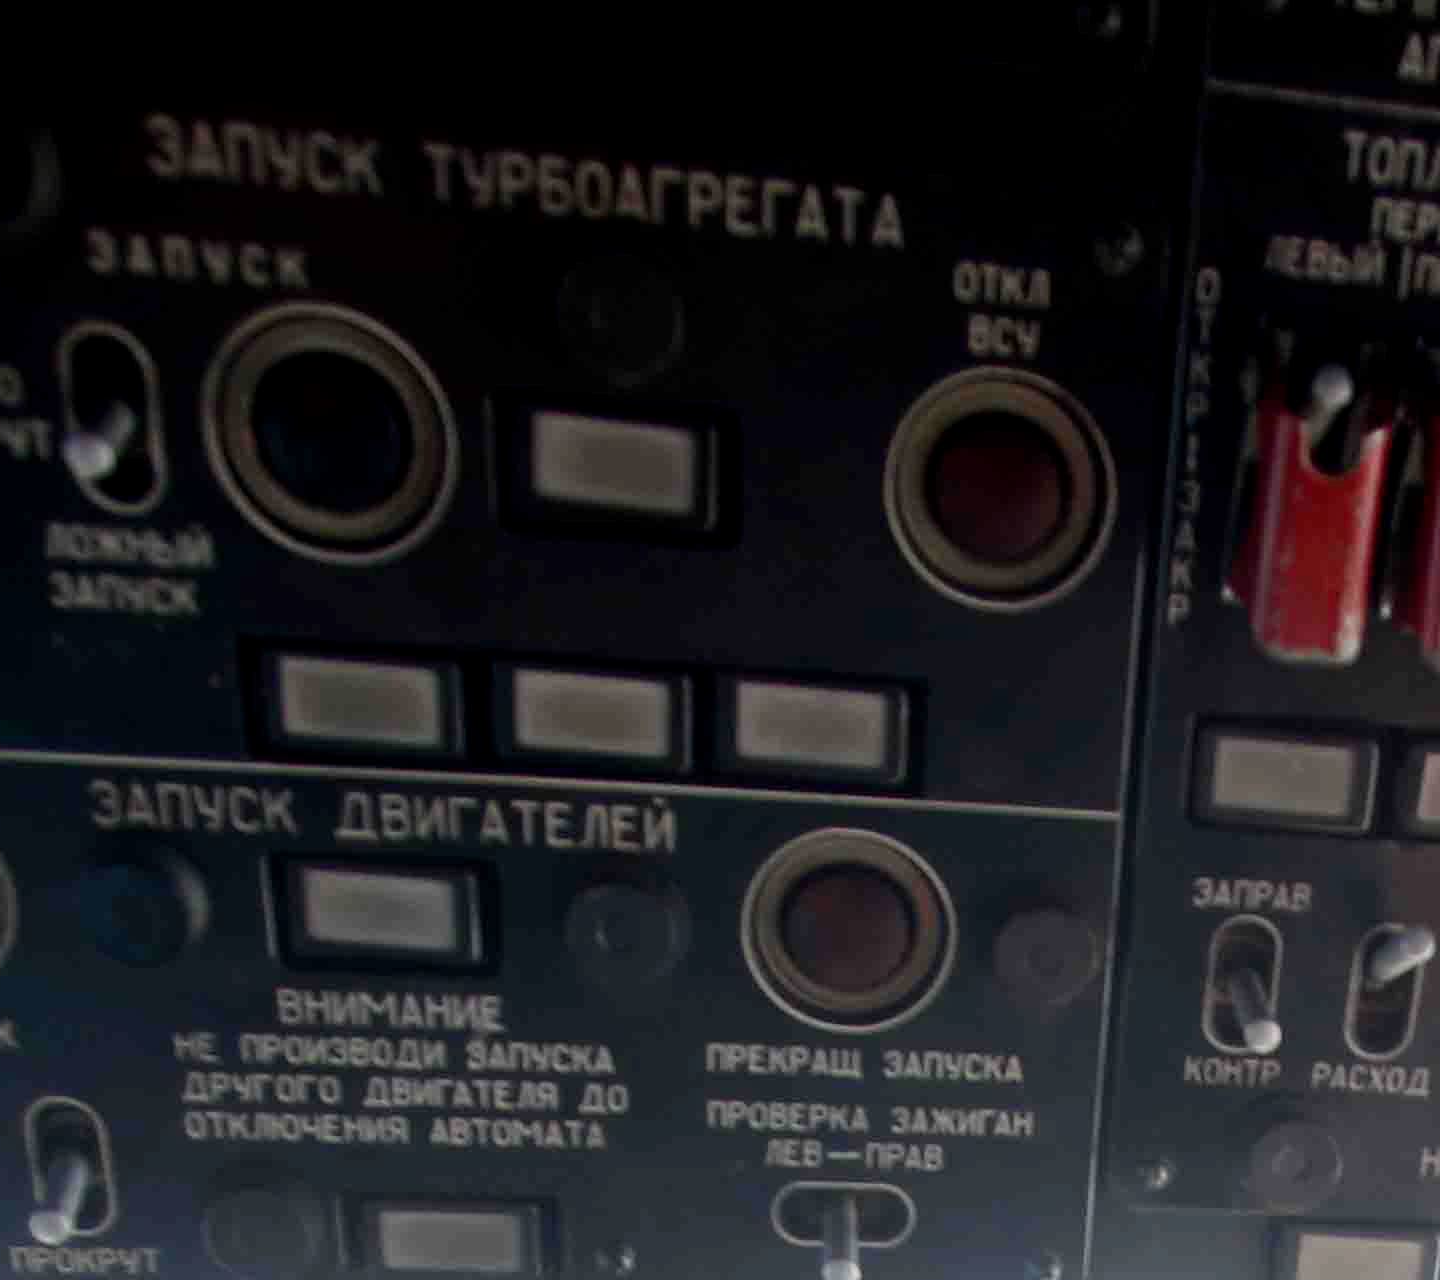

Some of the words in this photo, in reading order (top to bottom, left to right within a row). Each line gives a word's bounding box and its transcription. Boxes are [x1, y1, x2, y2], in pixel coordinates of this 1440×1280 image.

[144, 110, 383, 196] ЗАПУСК
[422, 139, 905, 249] ТУРБОАГРЕГАТА
[85, 226, 309, 289] ЗАПУСК
[968, 313, 1042, 360] ВСУ
[48, 569, 202, 616] ЗАПУСК
[86, 776, 301, 838] ЗАПУСК
[333, 790, 679, 854] ДВИГАТЕЛЕЙ
[1191, 875, 1314, 910] ЗАПРАВ
[275, 987, 508, 1033] ВНИМАНИЕ
[171, 1031, 219, 1064] НЕ
[239, 1034, 447, 1070] ПРОИЗВОДИ
[465, 1040, 616, 1075] ЗАПУСКА
[705, 1042, 864, 1080] ПРЕКРАЩ
[882, 1048, 1024, 1085] ЗАПУСКА
[1184, 1056, 1282, 1087] КОНТР
[180, 1070, 342, 1106] ДРУГОГО
[362, 1076, 559, 1112] ДВИГАТЕЛЯ
[577, 1084, 630, 1116] ДО
[1310, 1061, 1432, 1100] РАСХОД
[183, 1111, 410, 1145] ОТКЛЮЧЕНИЯ
[429, 1117, 608, 1151] АВТОМАТА
[705, 1100, 869, 1134] ПРОВЕРКА
[890, 1106, 1035, 1138] ЗАЖИГАН
[10, 1245, 160, 1275] ПРОКРУТ
